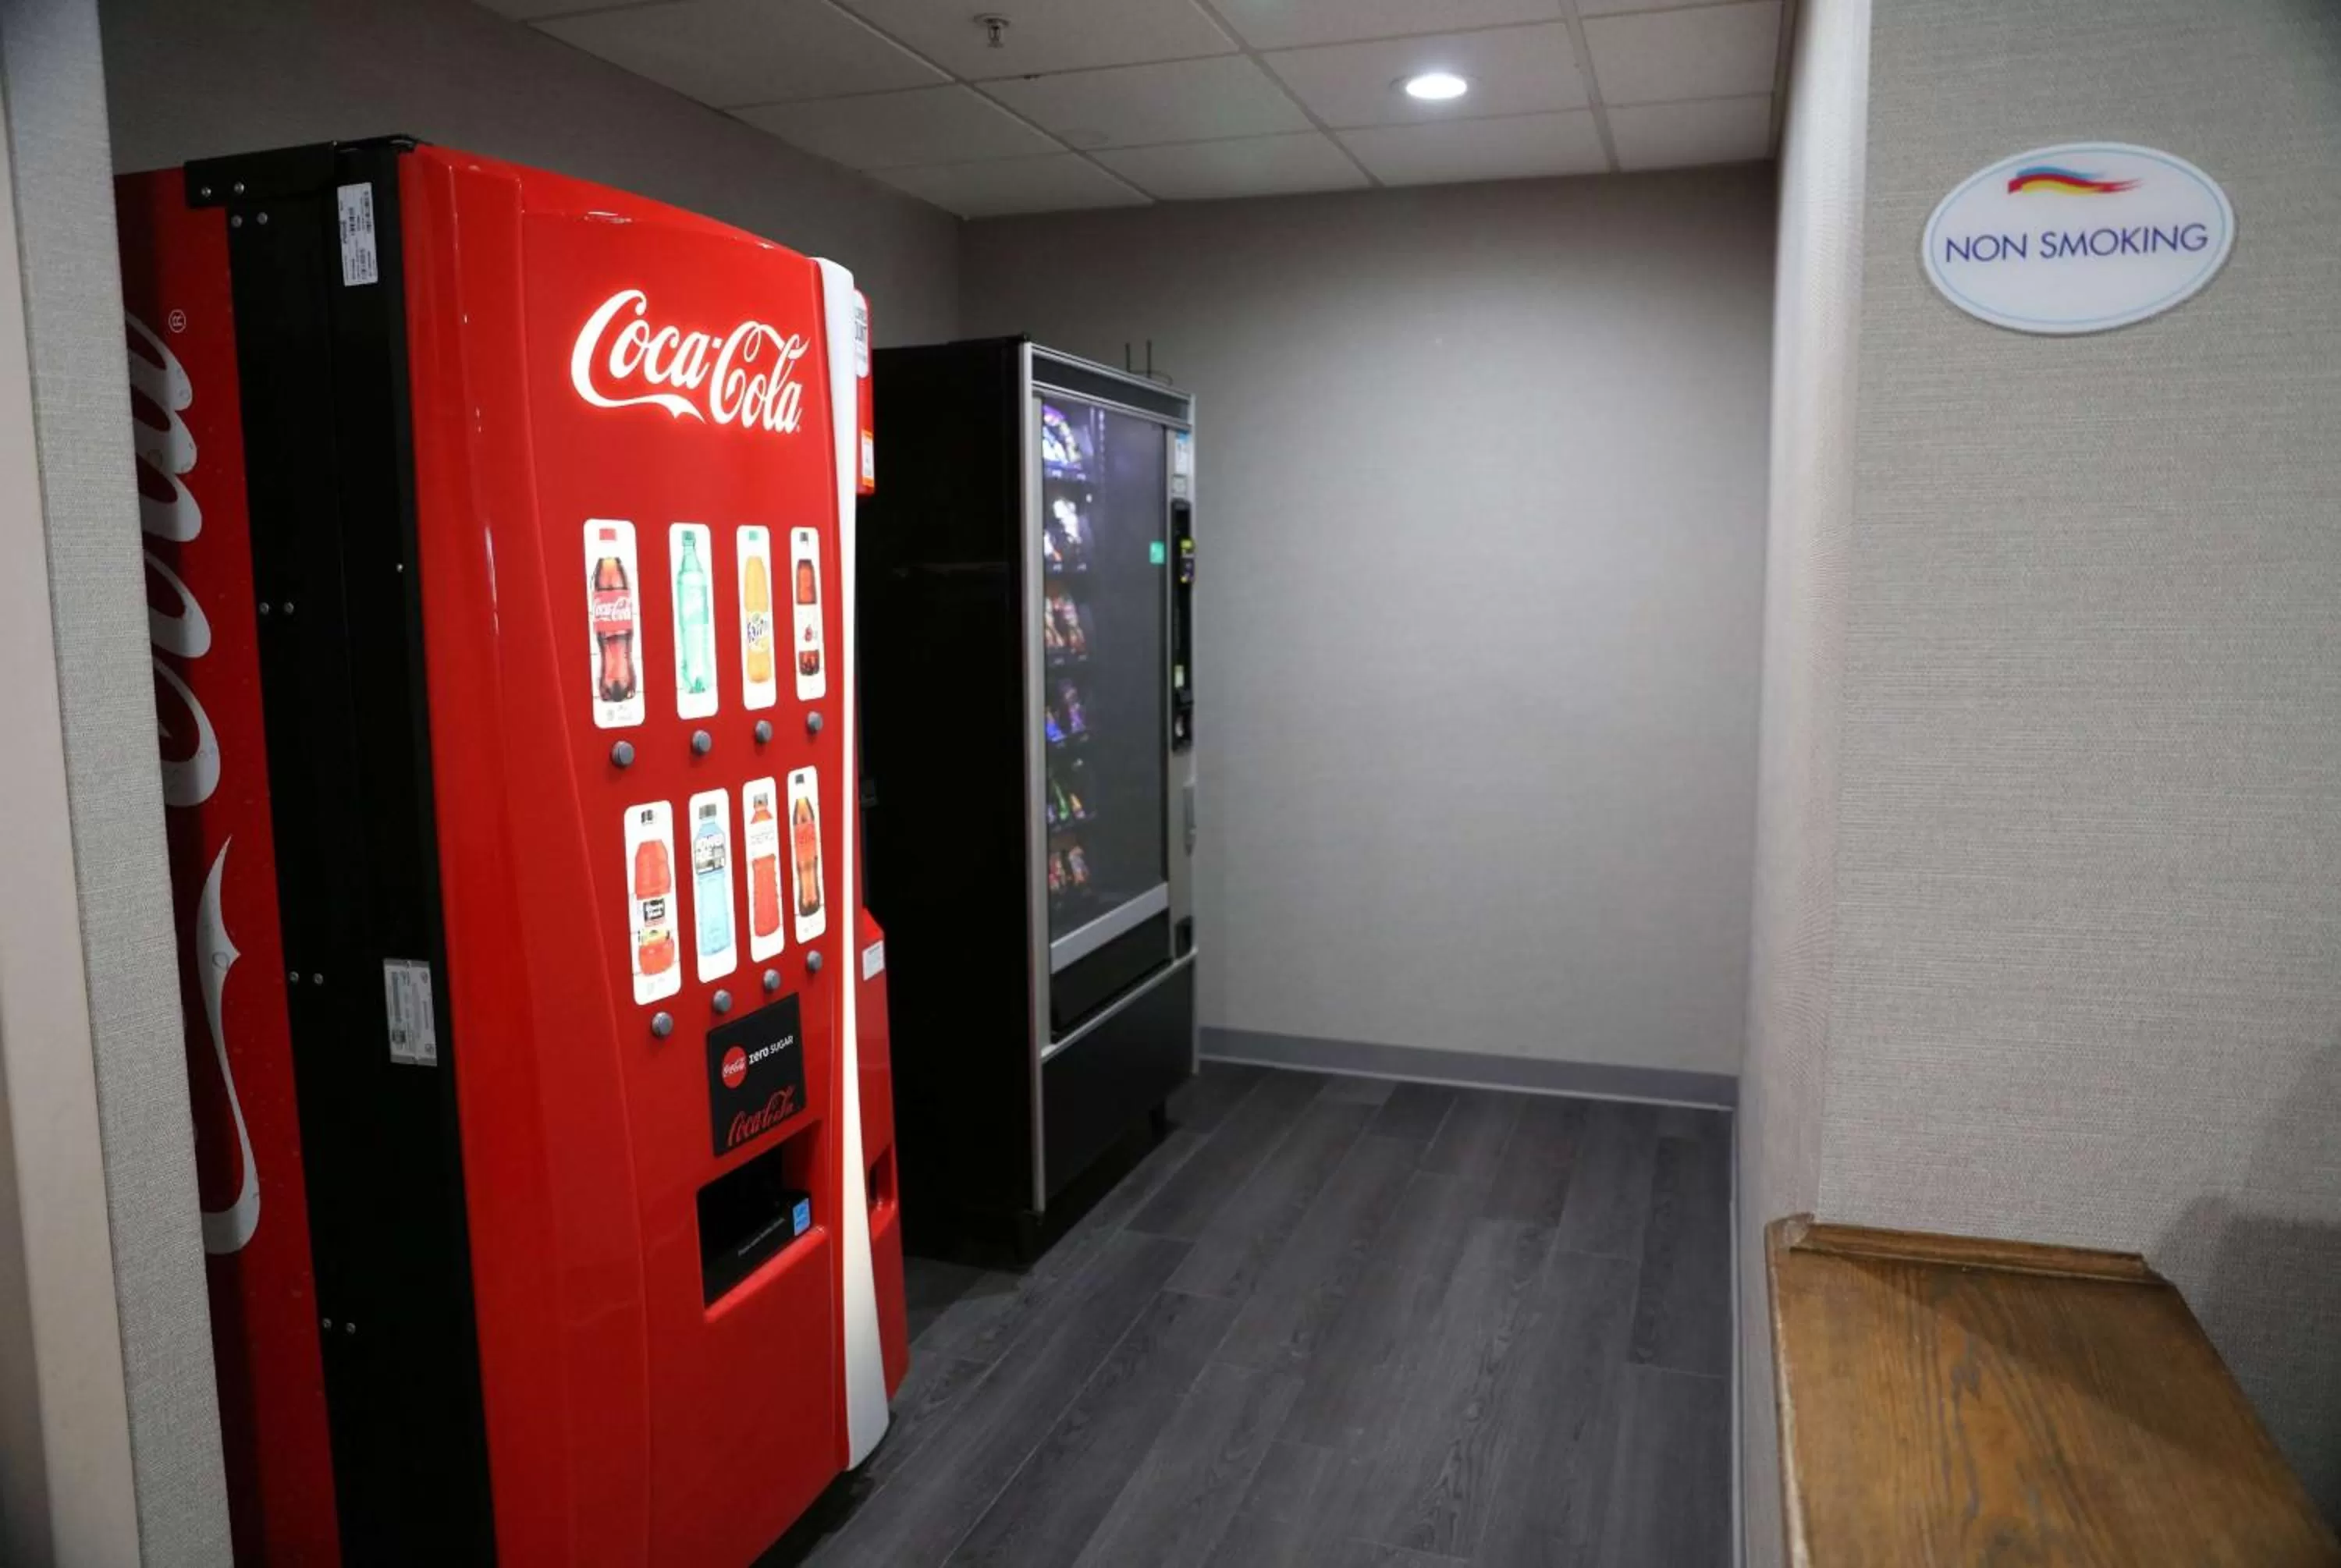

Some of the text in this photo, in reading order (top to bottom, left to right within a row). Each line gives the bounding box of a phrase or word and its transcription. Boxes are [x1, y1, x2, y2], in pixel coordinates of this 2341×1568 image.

[1945, 222, 2209, 263] NON SMOKING
[571, 289, 811, 433] Coca-Cola
[748, 1046, 769, 1065] zero
[769, 1035, 794, 1054] SUGAR
